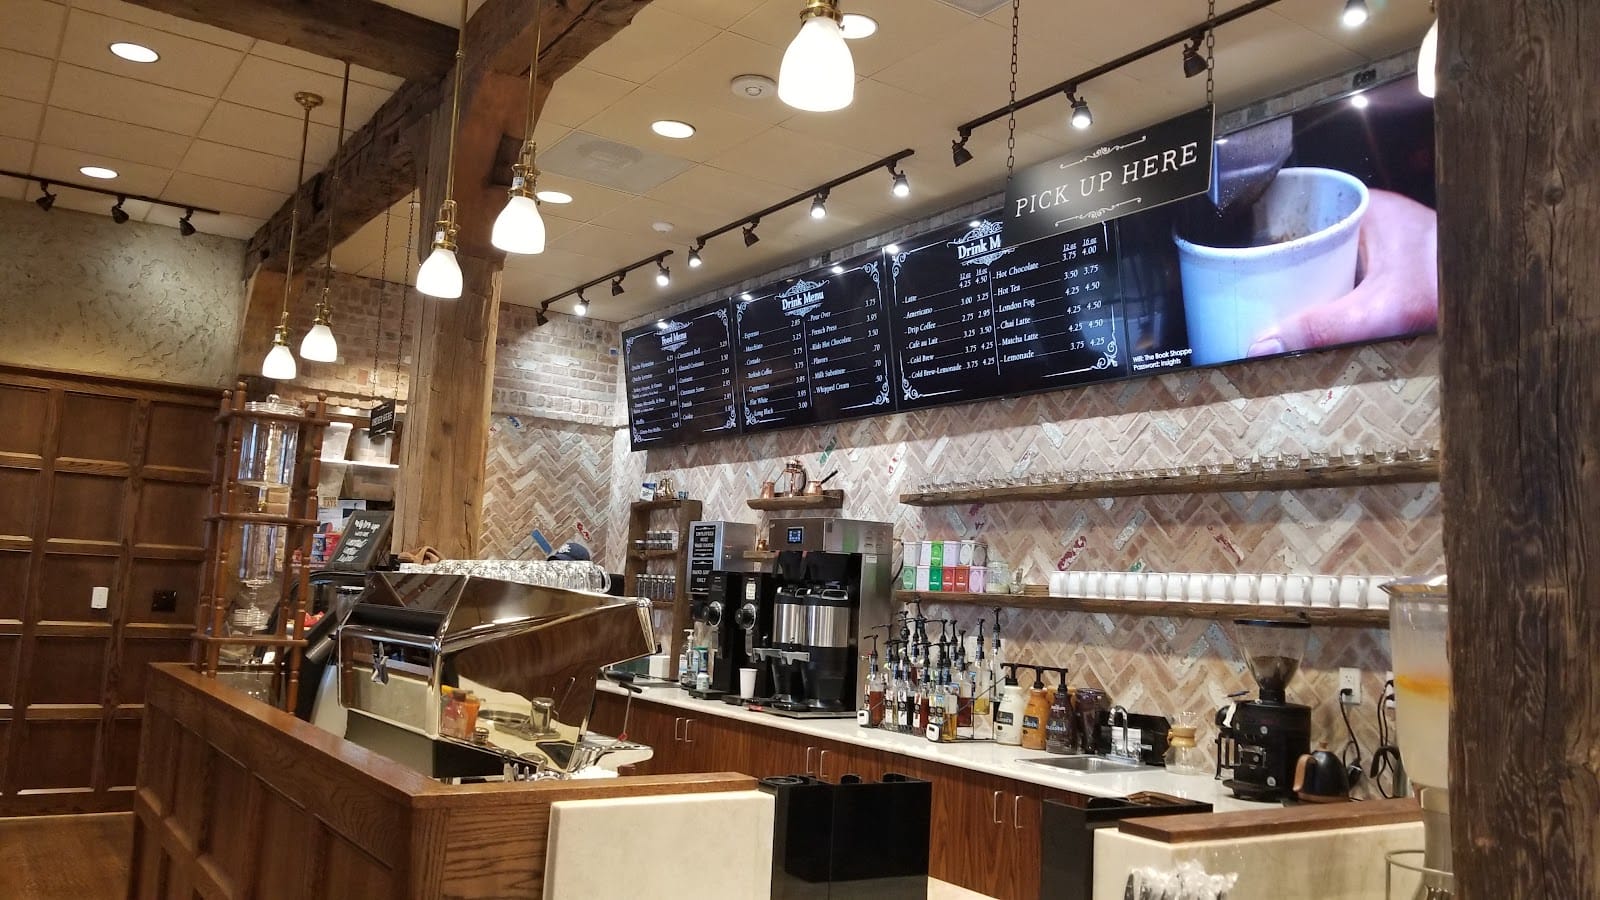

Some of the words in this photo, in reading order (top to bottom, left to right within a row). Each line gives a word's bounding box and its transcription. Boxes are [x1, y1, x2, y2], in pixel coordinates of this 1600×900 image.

[1015, 184, 1069, 217] PICK
[1080, 171, 1112, 197] UP
[1121, 142, 1198, 184] HERE
[957, 239, 988, 259] Drink
[1082, 239, 1089, 247] 16
[996, 271, 1007, 280] Hot
[1008, 262, 1039, 275] Chocolate
[1062, 251, 1077, 261] 3.75
[1082, 245, 1097, 256] 4.00
[959, 280, 971, 289] 4.25
[975, 275, 988, 285] 4.50
[997, 287, 1009, 296] Hot
[1010, 284, 1021, 293] Tea
[1063, 269, 1078, 280] 3.50
[1083, 264, 1099, 275] 3.75
[782, 295, 802, 310] Drink
[803, 291, 824, 304] Menu
[865, 298, 876, 307] 3.75
[906, 308, 933, 319] Americano
[960, 296, 973, 306] 3.00
[977, 292, 989, 302] 3.25
[999, 301, 1022, 313] London
[1023, 299, 1035, 308] Fog
[1065, 286, 1080, 296] 4.25
[1085, 281, 1100, 291] 4.50
[812, 327, 825, 336] French
[867, 313, 877, 322] 3.95
[907, 326, 919, 335] Drip
[920, 321, 936, 331] Coffee
[962, 313, 974, 322] 2.75
[978, 309, 990, 318] 2.95
[1000, 320, 1014, 329] Chai
[1015, 317, 1031, 326] Latte
[1067, 305, 1081, 315] 4.25
[1086, 300, 1102, 311] 4.50
[662, 333, 673, 346] Food
[673, 332, 687, 342] Menu
[745, 331, 760, 340] Espresso
[812, 342, 821, 350] Kids
[822, 340, 830, 348] Hot
[831, 336, 852, 346] Chocolate
[868, 329, 878, 337] 3.50
[928, 337, 938, 345] Lait
[963, 329, 976, 338] 3.25
[979, 325, 992, 335] 3.50
[1002, 335, 1022, 346] Matcha
[1023, 333, 1039, 341] Latte
[1068, 323, 1083, 332] 4.25
[1088, 319, 1103, 329] 4.50
[910, 355, 921, 364] Cold
[922, 354, 935, 362] Brew
[965, 345, 977, 354] 3.75
[980, 341, 994, 351] 4.25
[1003, 350, 1035, 363] Lemonade
[1070, 341, 1084, 351] 3.75
[1089, 337, 1104, 346] 4.25
[1170, 349, 1192, 357] Shoppe
[761, 368, 772, 376] Coffee
[911, 371, 923, 379] Cold
[966, 360, 979, 369] 3.75
[982, 357, 995, 366] 4.25
[1133, 361, 1160, 370] Password:
[1161, 358, 1181, 366] Insights
[815, 371, 824, 379] Milk
[816, 384, 835, 394] Whipped
